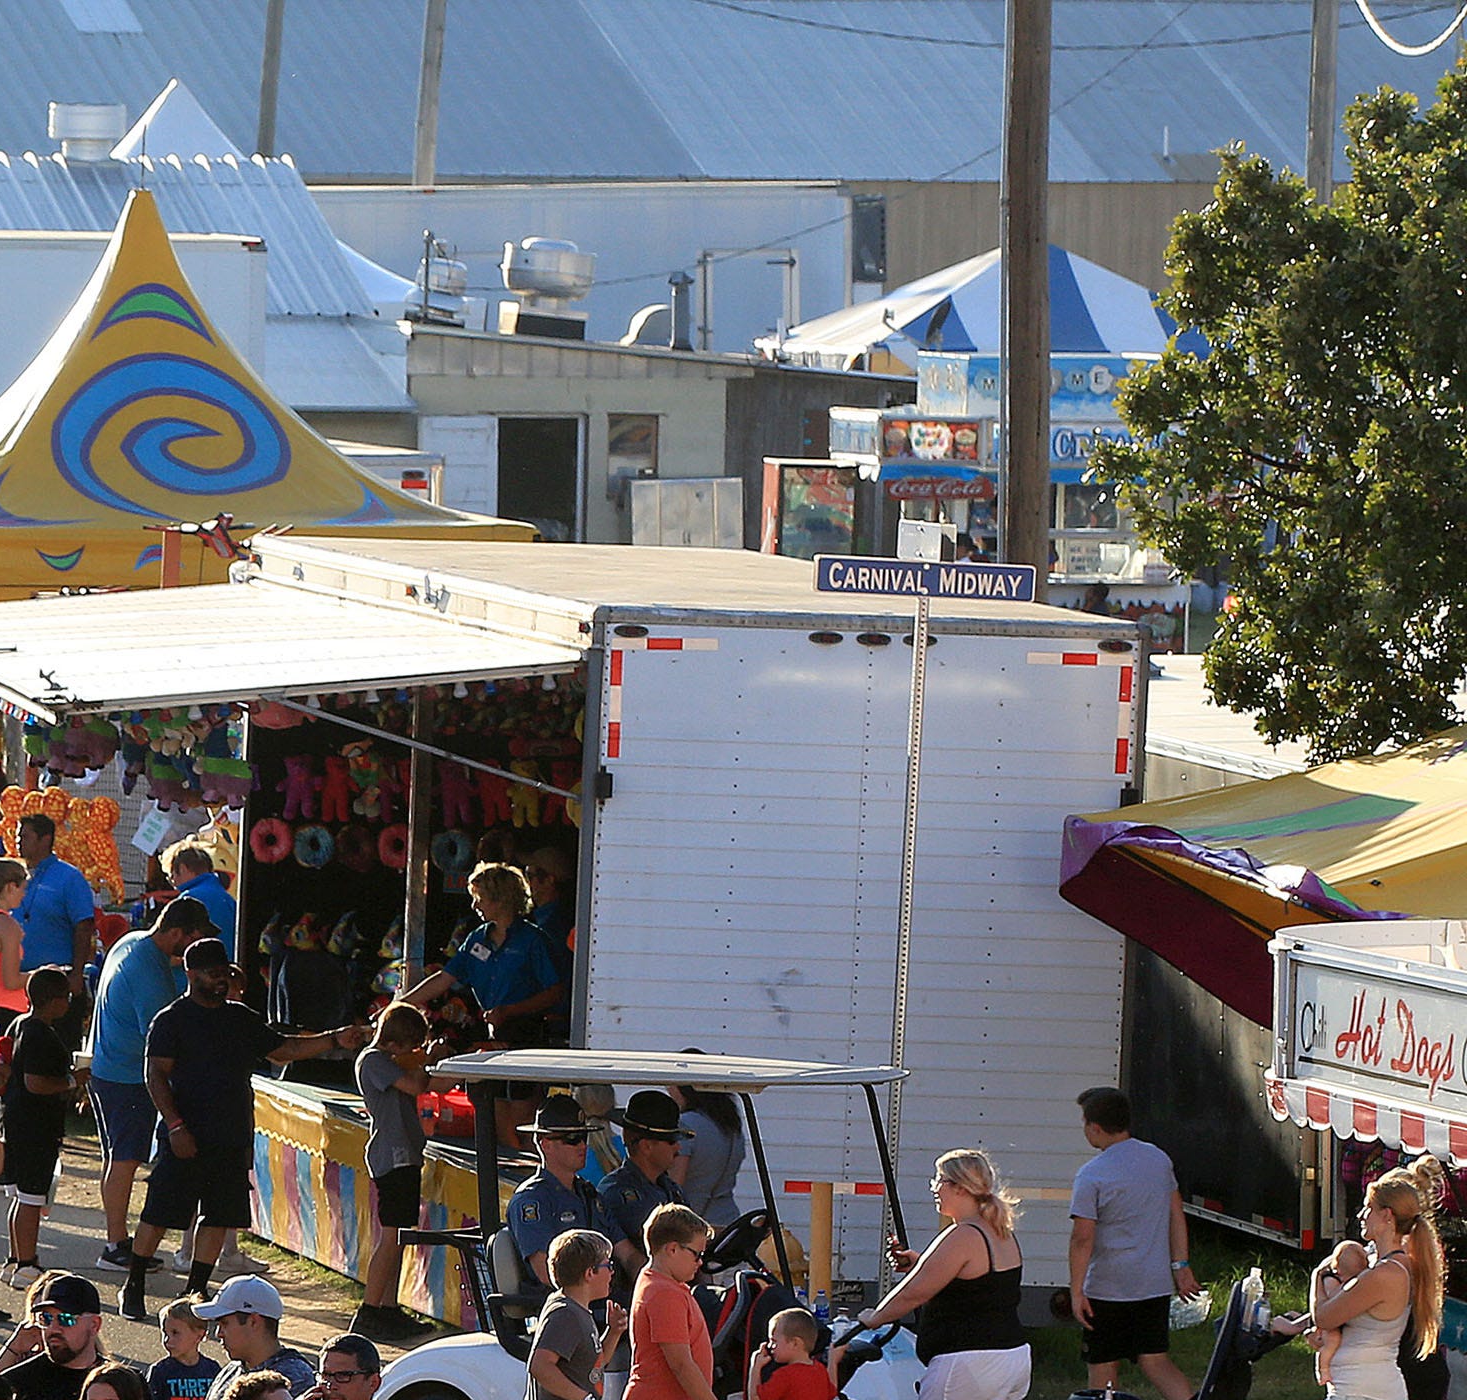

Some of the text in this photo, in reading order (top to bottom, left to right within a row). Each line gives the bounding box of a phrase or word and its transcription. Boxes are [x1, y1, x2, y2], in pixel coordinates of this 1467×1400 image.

[828, 562, 1024, 598] CARNIVAL MIDWAY
[1335, 989, 1387, 1067] Hot
[1391, 999, 1455, 1101] Dogs
